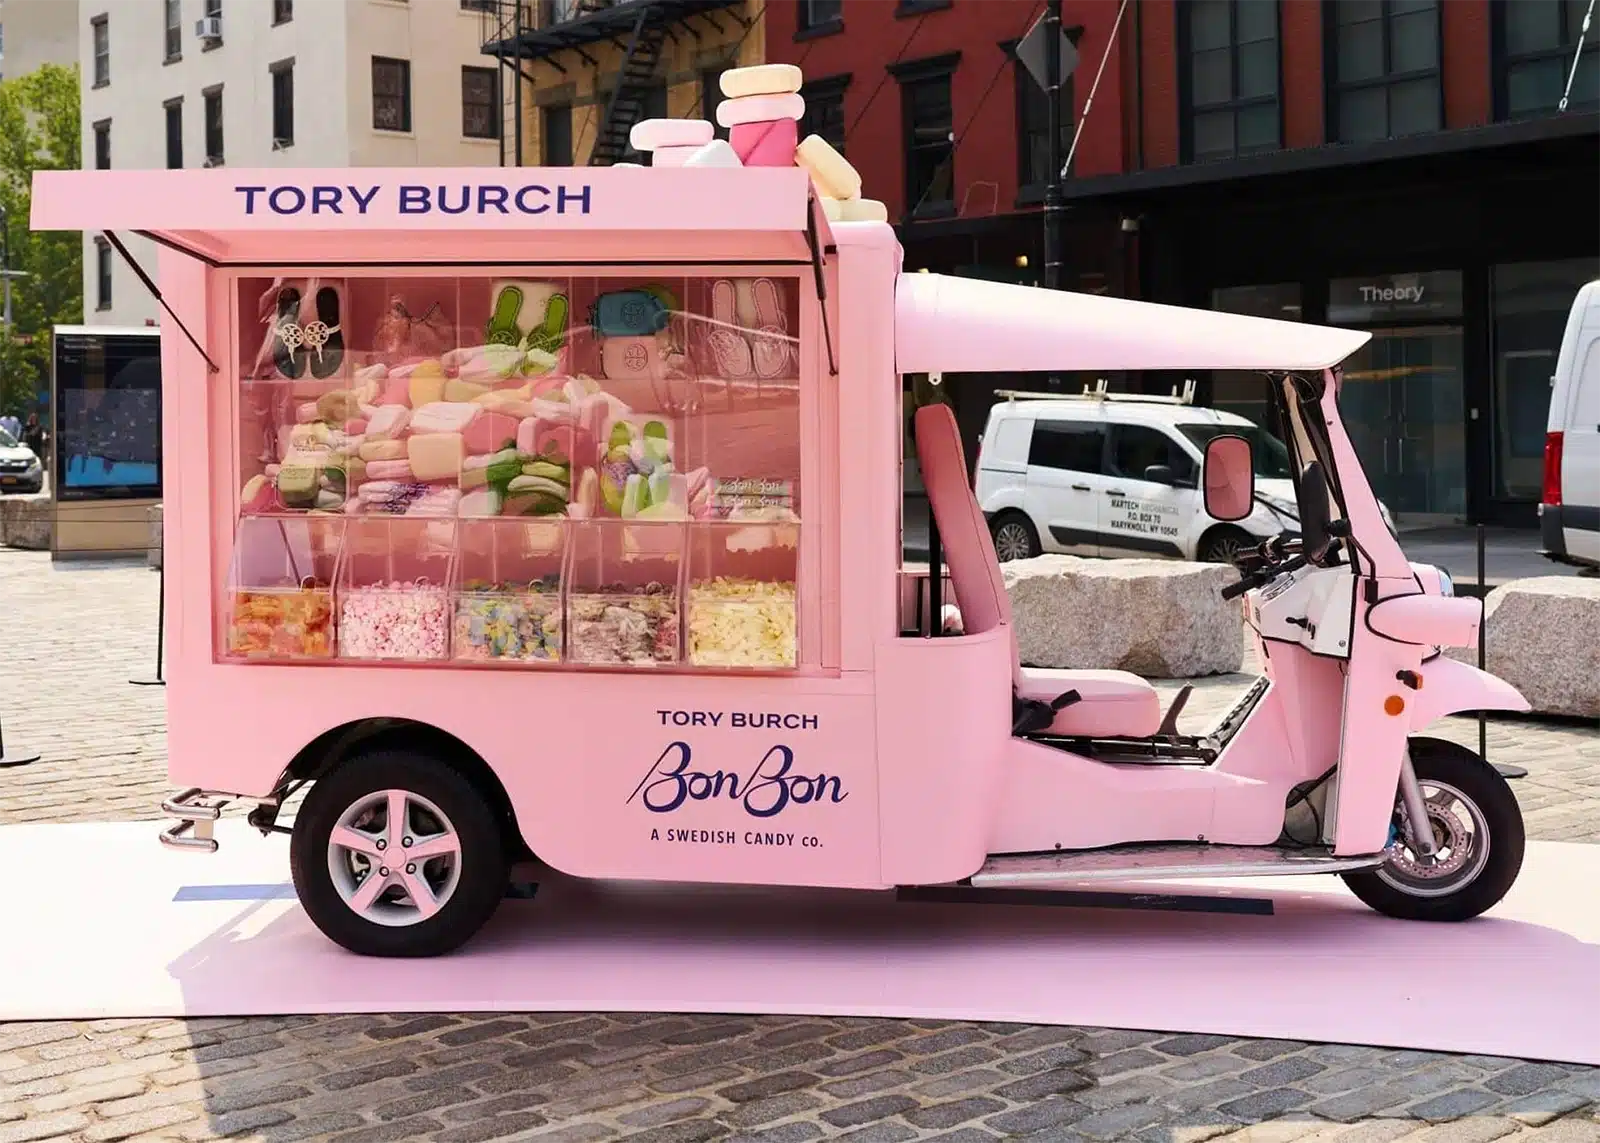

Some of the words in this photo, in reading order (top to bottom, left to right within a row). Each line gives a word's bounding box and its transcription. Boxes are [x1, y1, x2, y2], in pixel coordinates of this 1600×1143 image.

[234, 185, 381, 215] TORY
[398, 184, 592, 215] BURCH
[1358, 284, 1425, 303] Theory
[1111, 499, 1139, 510] MARTECH
[1140, 513, 1152, 522] BOX
[1150, 524, 1159, 532] NY
[656, 710, 723, 727] TORY
[731, 712, 818, 729] BURCH
[650, 828, 660, 841] A
[667, 829, 736, 844] SWEDISH
[744, 832, 795, 846] CANDY
